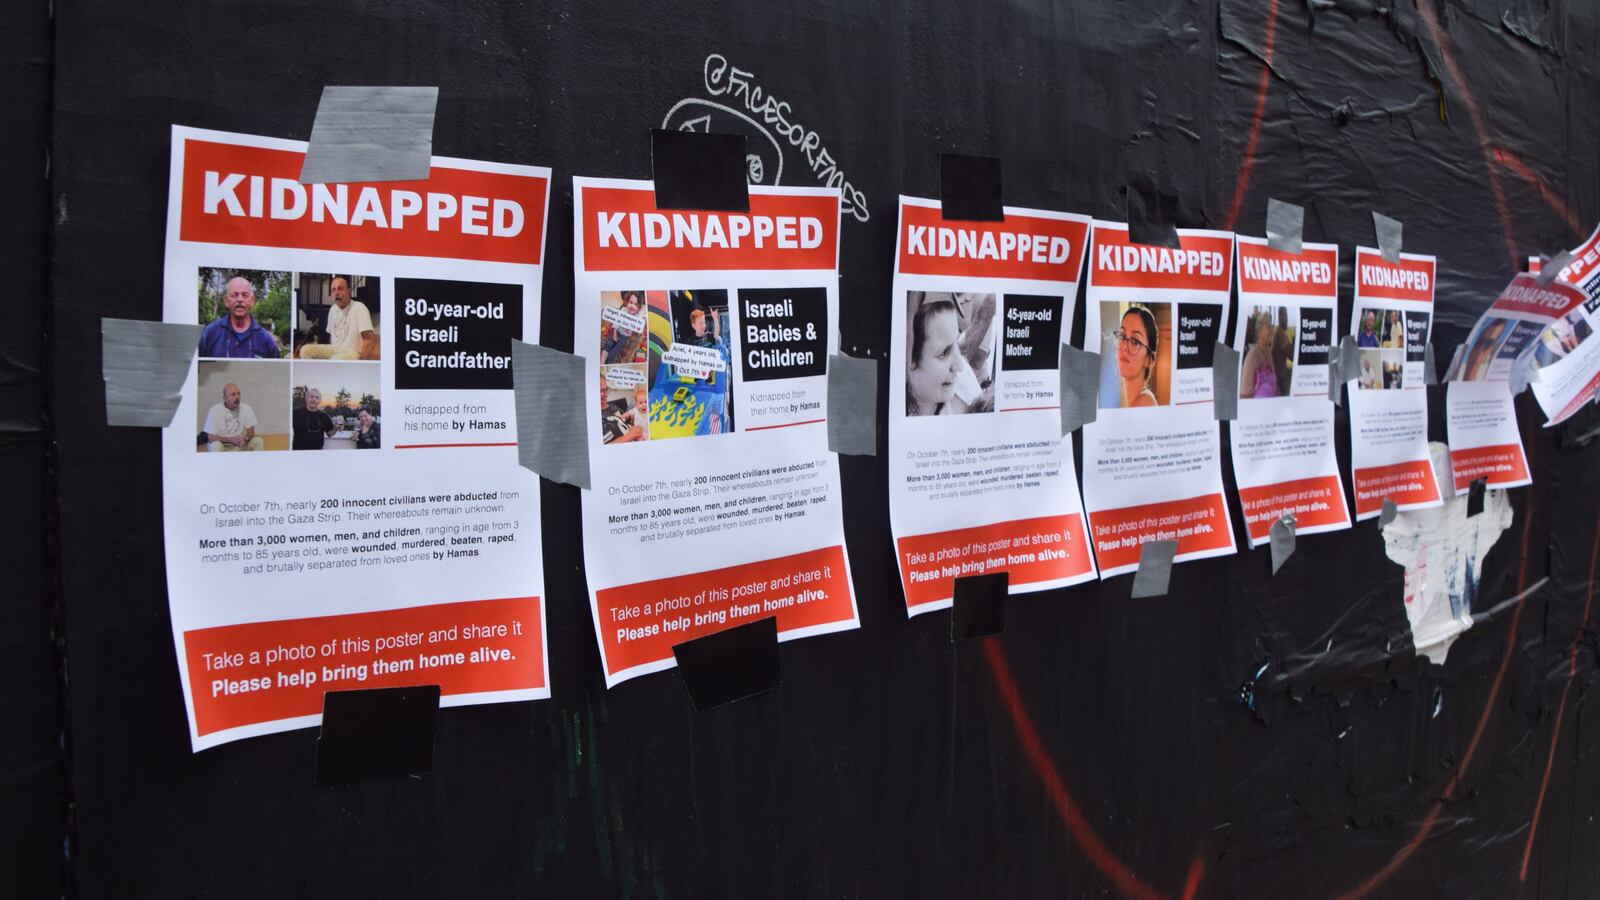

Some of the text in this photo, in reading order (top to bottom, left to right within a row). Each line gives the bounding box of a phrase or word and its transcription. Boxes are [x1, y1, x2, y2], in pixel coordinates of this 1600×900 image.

[203, 170, 525, 238] KIDNAPPED
[597, 210, 823, 249] KIDNAPPED
[908, 225, 1070, 264] KIDNAPPED
[1098, 244, 1224, 276] KIDNAPPED
[1243, 256, 1331, 284] KIDNAPPED
[1362, 265, 1429, 291] KIDNAPPED
[405, 298, 504, 320] 80-year-old
[745, 299, 793, 319] Israeli
[1502, 286, 1570, 309] KIDNAPPED
[1007, 308, 1052, 323] 45-year-old
[405, 324, 458, 343] Israeli
[747, 322, 817, 344] Babies &
[1007, 326, 1030, 338] Israeli
[405, 350, 511, 369] Grandfather
[748, 349, 814, 369] Children
[1006, 344, 1032, 357] Mother
[750, 390, 806, 402] Kidnapped from
[405, 404, 487, 416] Kidnapped from
[750, 402, 820, 416] their home by Hamas
[404, 420, 506, 432] his home by Hamas
[200, 491, 519, 514] On October 7th, nearly 200 innocent civilians were abducted from
[608, 515, 628, 523] More
[630, 512, 648, 520] than
[650, 508, 671, 518] 3,000
[673, 505, 702, 514] women,
[724, 499, 736, 508] and
[800, 488, 810, 497] age
[215, 505, 505, 527] Israel into the Gaza Strip. Their whereabouts remain unknown.
[199, 520, 519, 548] More than 3,000 women, men, and children, ranging in age from 3
[202, 533, 517, 562] months to 85 years old, were wounded, murdered, beaten, raped,
[906, 531, 1071, 565] Take a photo of this poster and share it
[243, 549, 480, 574] and brutally separated from loved ones by Hamas.
[910, 549, 1070, 583] Please help bring them home alive.
[610, 566, 830, 622] Take a photo of this poster and share it
[617, 589, 828, 643] Please help bring them home alive.
[203, 620, 522, 670] Take a photo of this poster and share it
[212, 646, 516, 697] Please help bring them home alive.
